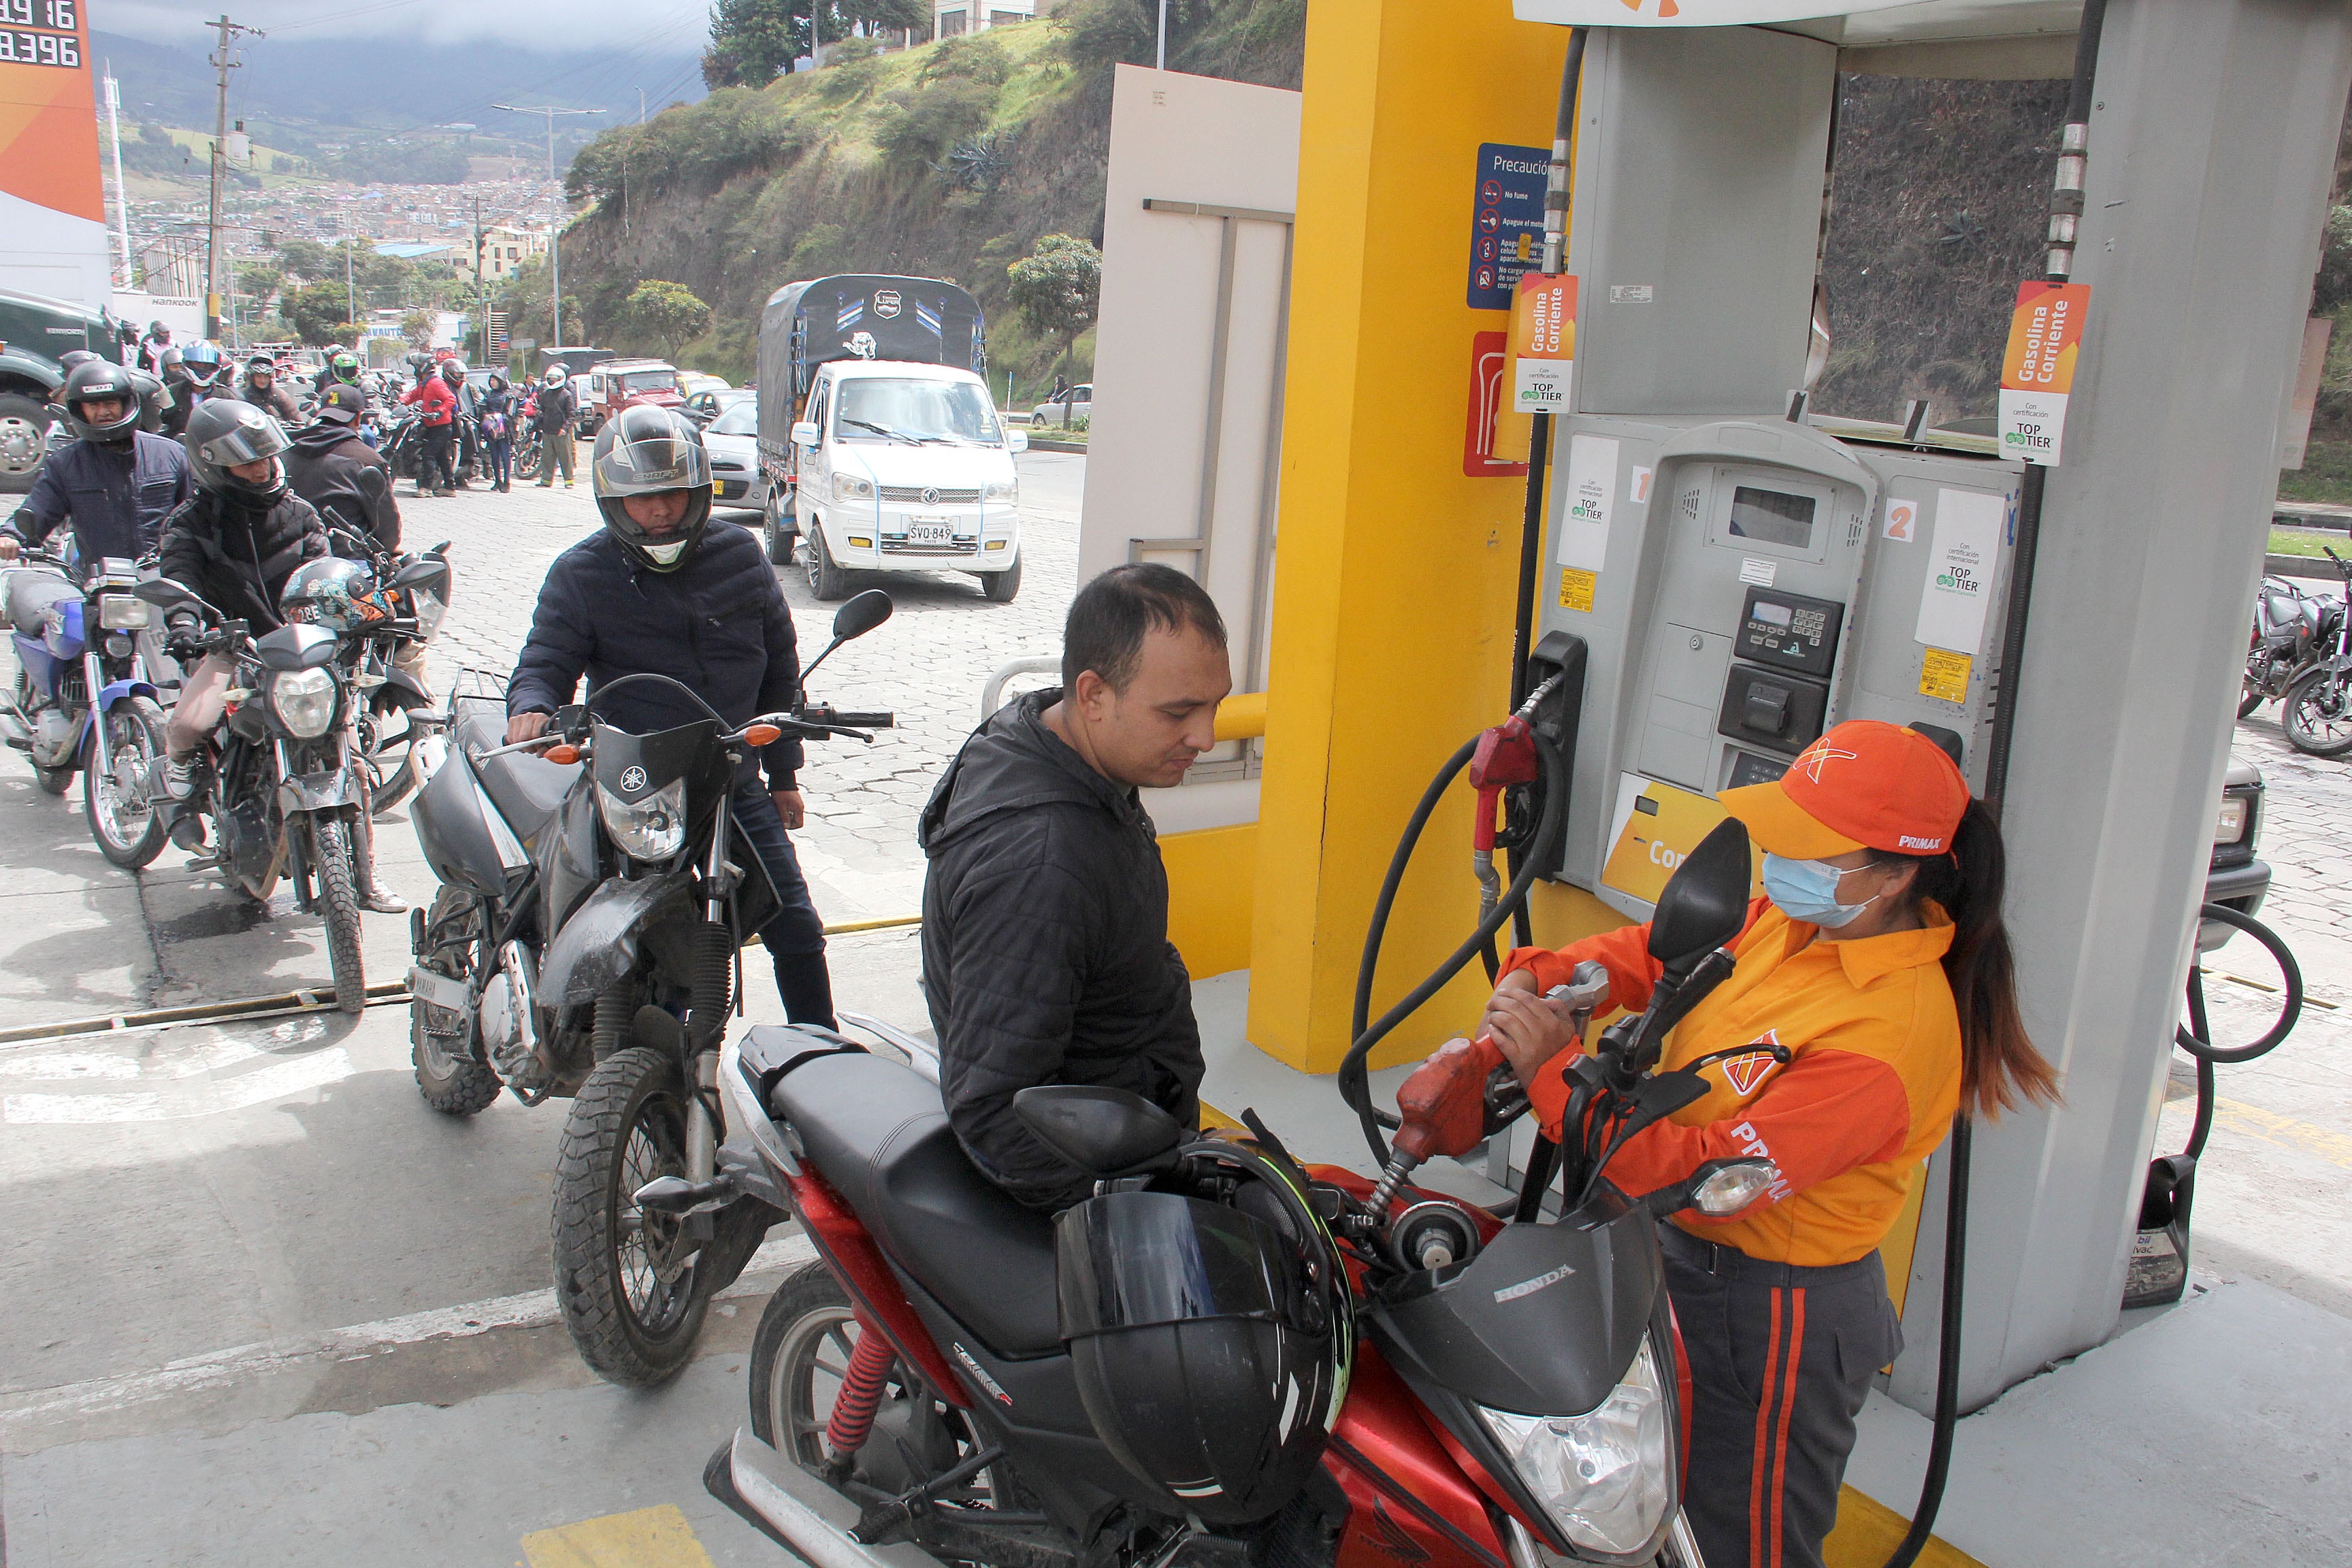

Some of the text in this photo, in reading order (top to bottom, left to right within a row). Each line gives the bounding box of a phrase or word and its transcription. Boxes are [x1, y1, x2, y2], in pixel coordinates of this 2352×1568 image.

[0, 31, 78, 66] 8.396
[1494, 156, 1548, 175] Precaució
[1503, 218, 1524, 227] Apague
[1501, 240, 1519, 248] Apagu
[1531, 293, 1547, 353] Gasolina
[1546, 287, 1563, 353] Corriente
[2018, 306, 2048, 382] Gasolina
[2037, 300, 2068, 383] Corriente
[1532, 383, 1553, 392] TOP
[1539, 392, 1562, 401] TIER
[2013, 410, 2048, 418] certificación
[2016, 423, 2040, 435] TOP
[2025, 435, 2051, 448] TIER
[1638, 472, 1650, 501] 1
[1581, 499, 1597, 510] TOP
[1586, 509, 1602, 521] TIER
[1888, 506, 1912, 539] 2
[1946, 554, 1980, 565] internacional
[1948, 549, 1979, 558] certificación
[1949, 566, 1971, 579] TOP
[1955, 578, 1978, 592] TIER
[1898, 834, 1943, 850] PRIMAX
[1649, 839, 1687, 871] Cor
[1730, 1121, 1795, 1205] PRMA
[2137, 1235, 2151, 1244] bil
[2133, 1245, 2153, 1254] lvac
[1494, 1263, 1576, 1303] HONDA
